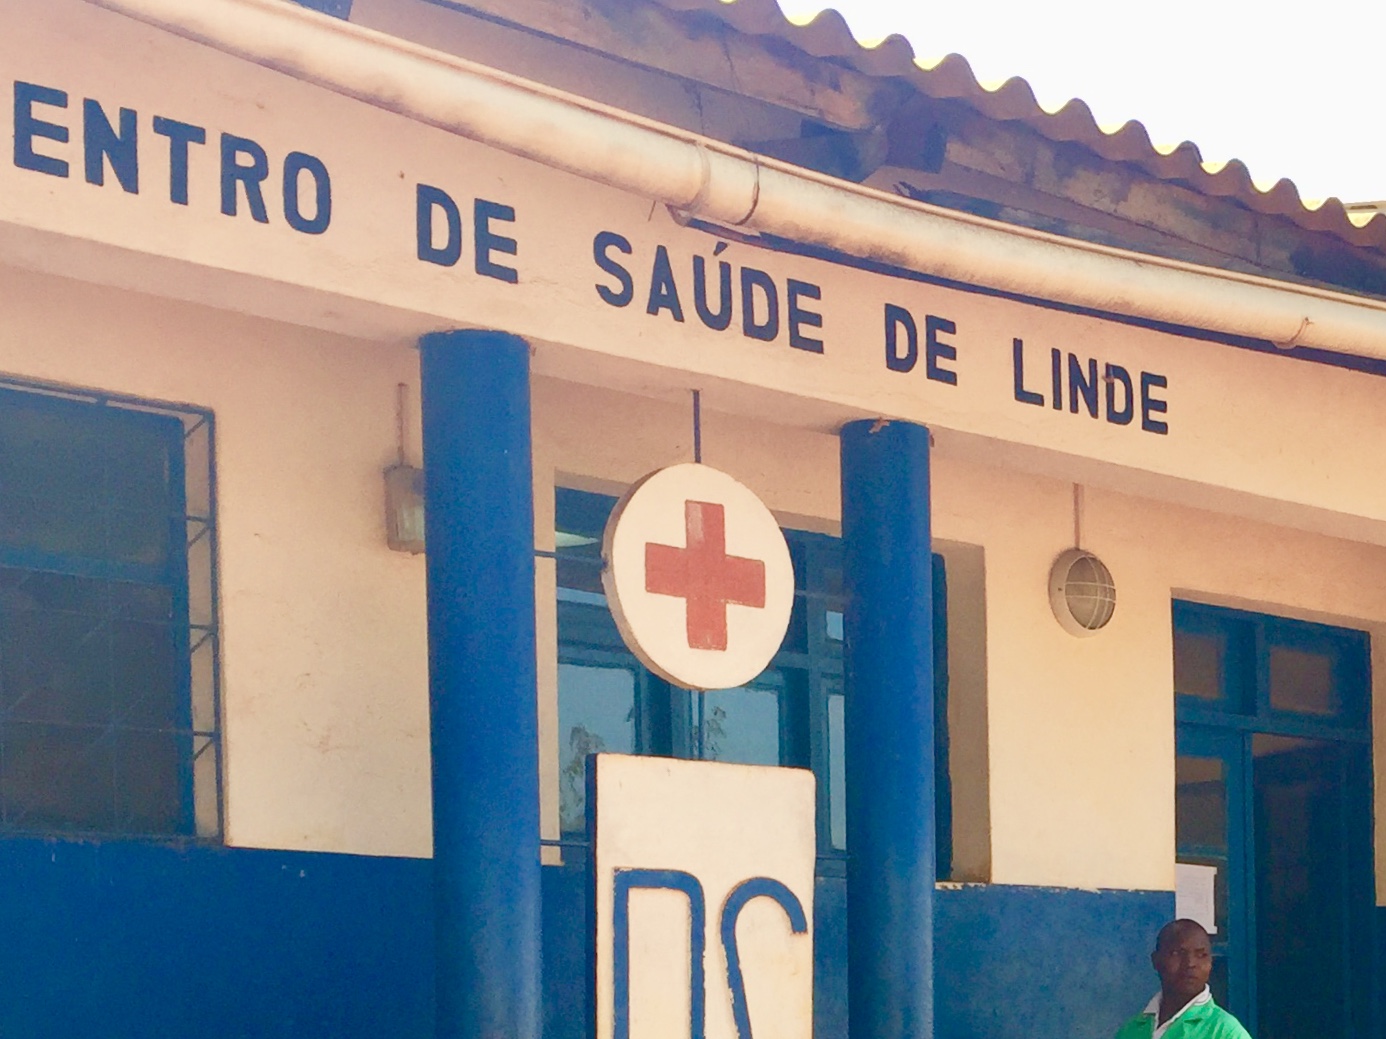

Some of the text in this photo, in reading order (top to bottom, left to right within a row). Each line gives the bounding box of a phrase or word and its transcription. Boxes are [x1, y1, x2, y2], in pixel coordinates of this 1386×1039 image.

[13, 80, 1169, 436] ENTRO DE SAÚDE DE LINDE
